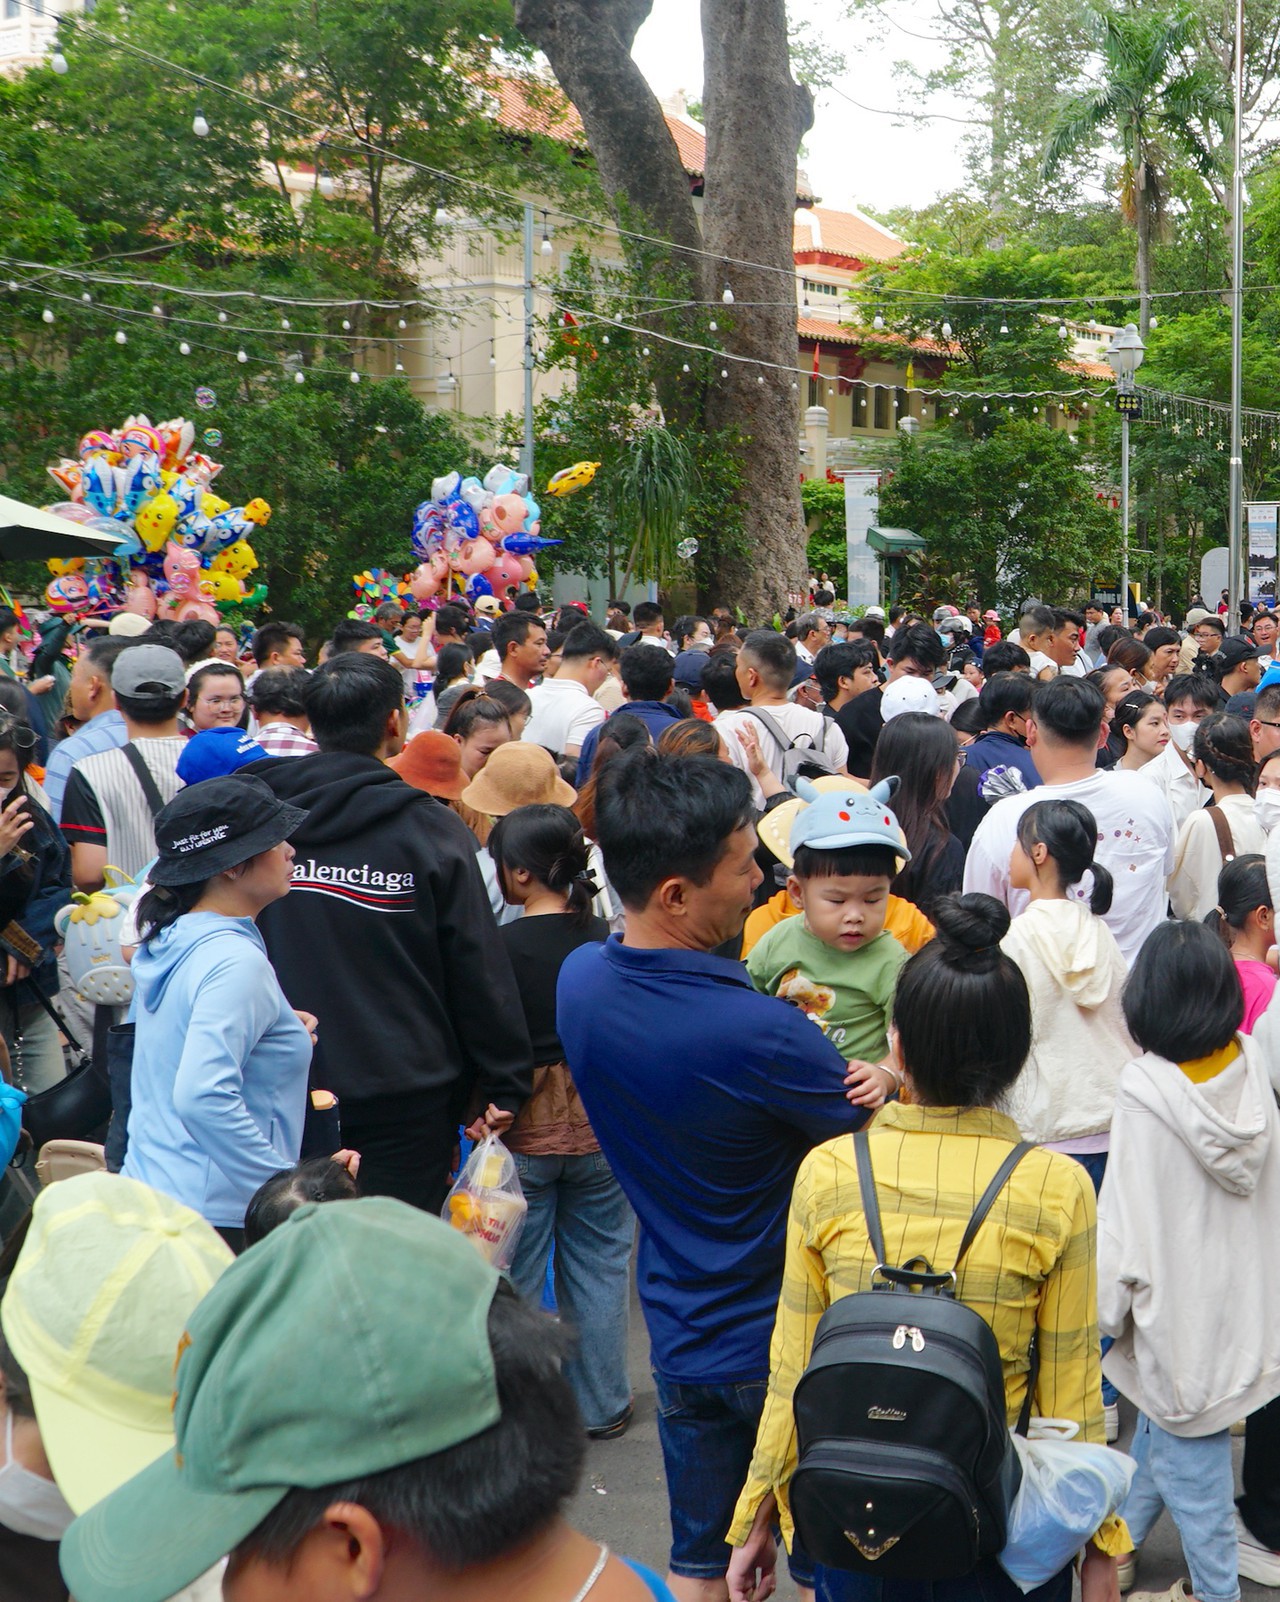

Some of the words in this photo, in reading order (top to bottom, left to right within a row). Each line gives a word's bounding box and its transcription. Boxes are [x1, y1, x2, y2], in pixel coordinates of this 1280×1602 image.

[171, 838, 189, 850] Just
[189, 834, 200, 844] fit
[200, 830, 212, 840] for
[292, 859, 415, 891] alenciaga
